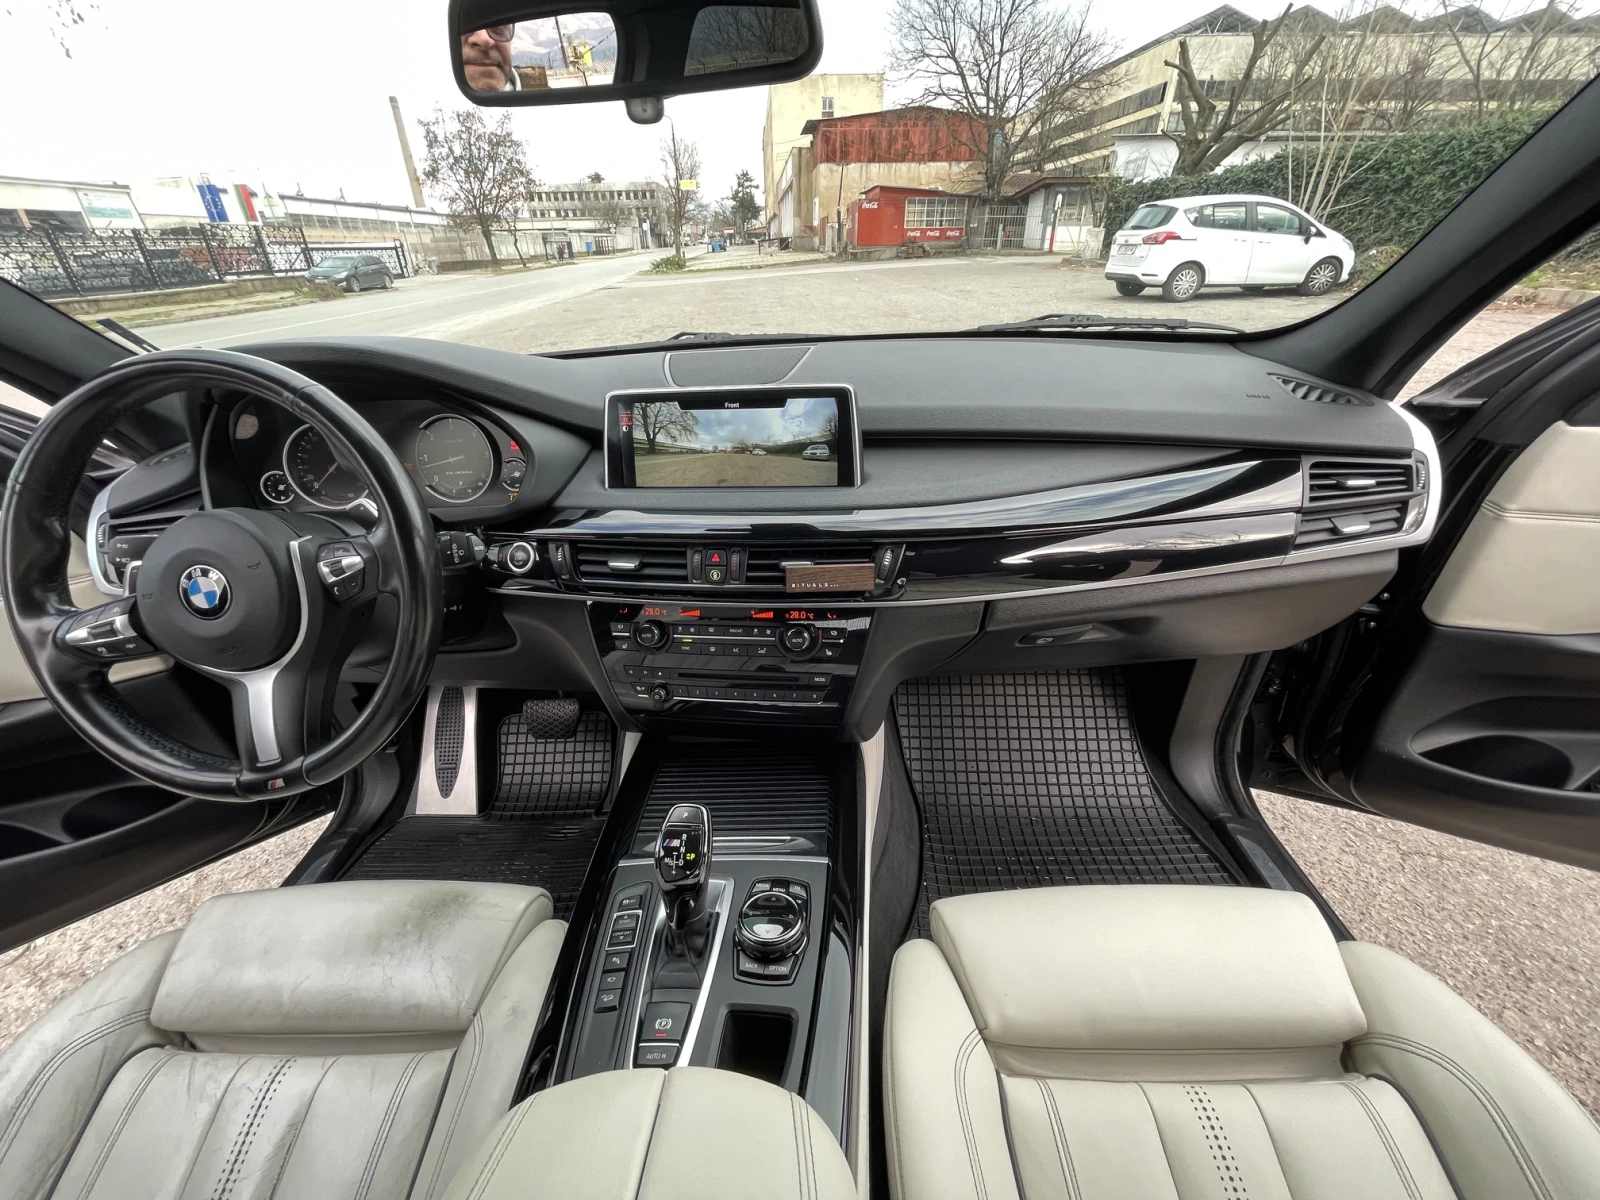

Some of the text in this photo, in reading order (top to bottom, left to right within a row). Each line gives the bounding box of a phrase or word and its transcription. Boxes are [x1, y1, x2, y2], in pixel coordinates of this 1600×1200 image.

[645, 607, 660, 616] 28.0
[790, 611, 806, 619] 28.0
[683, 811, 689, 819] P
[682, 833, 688, 841] R
[690, 853, 696, 861] P
